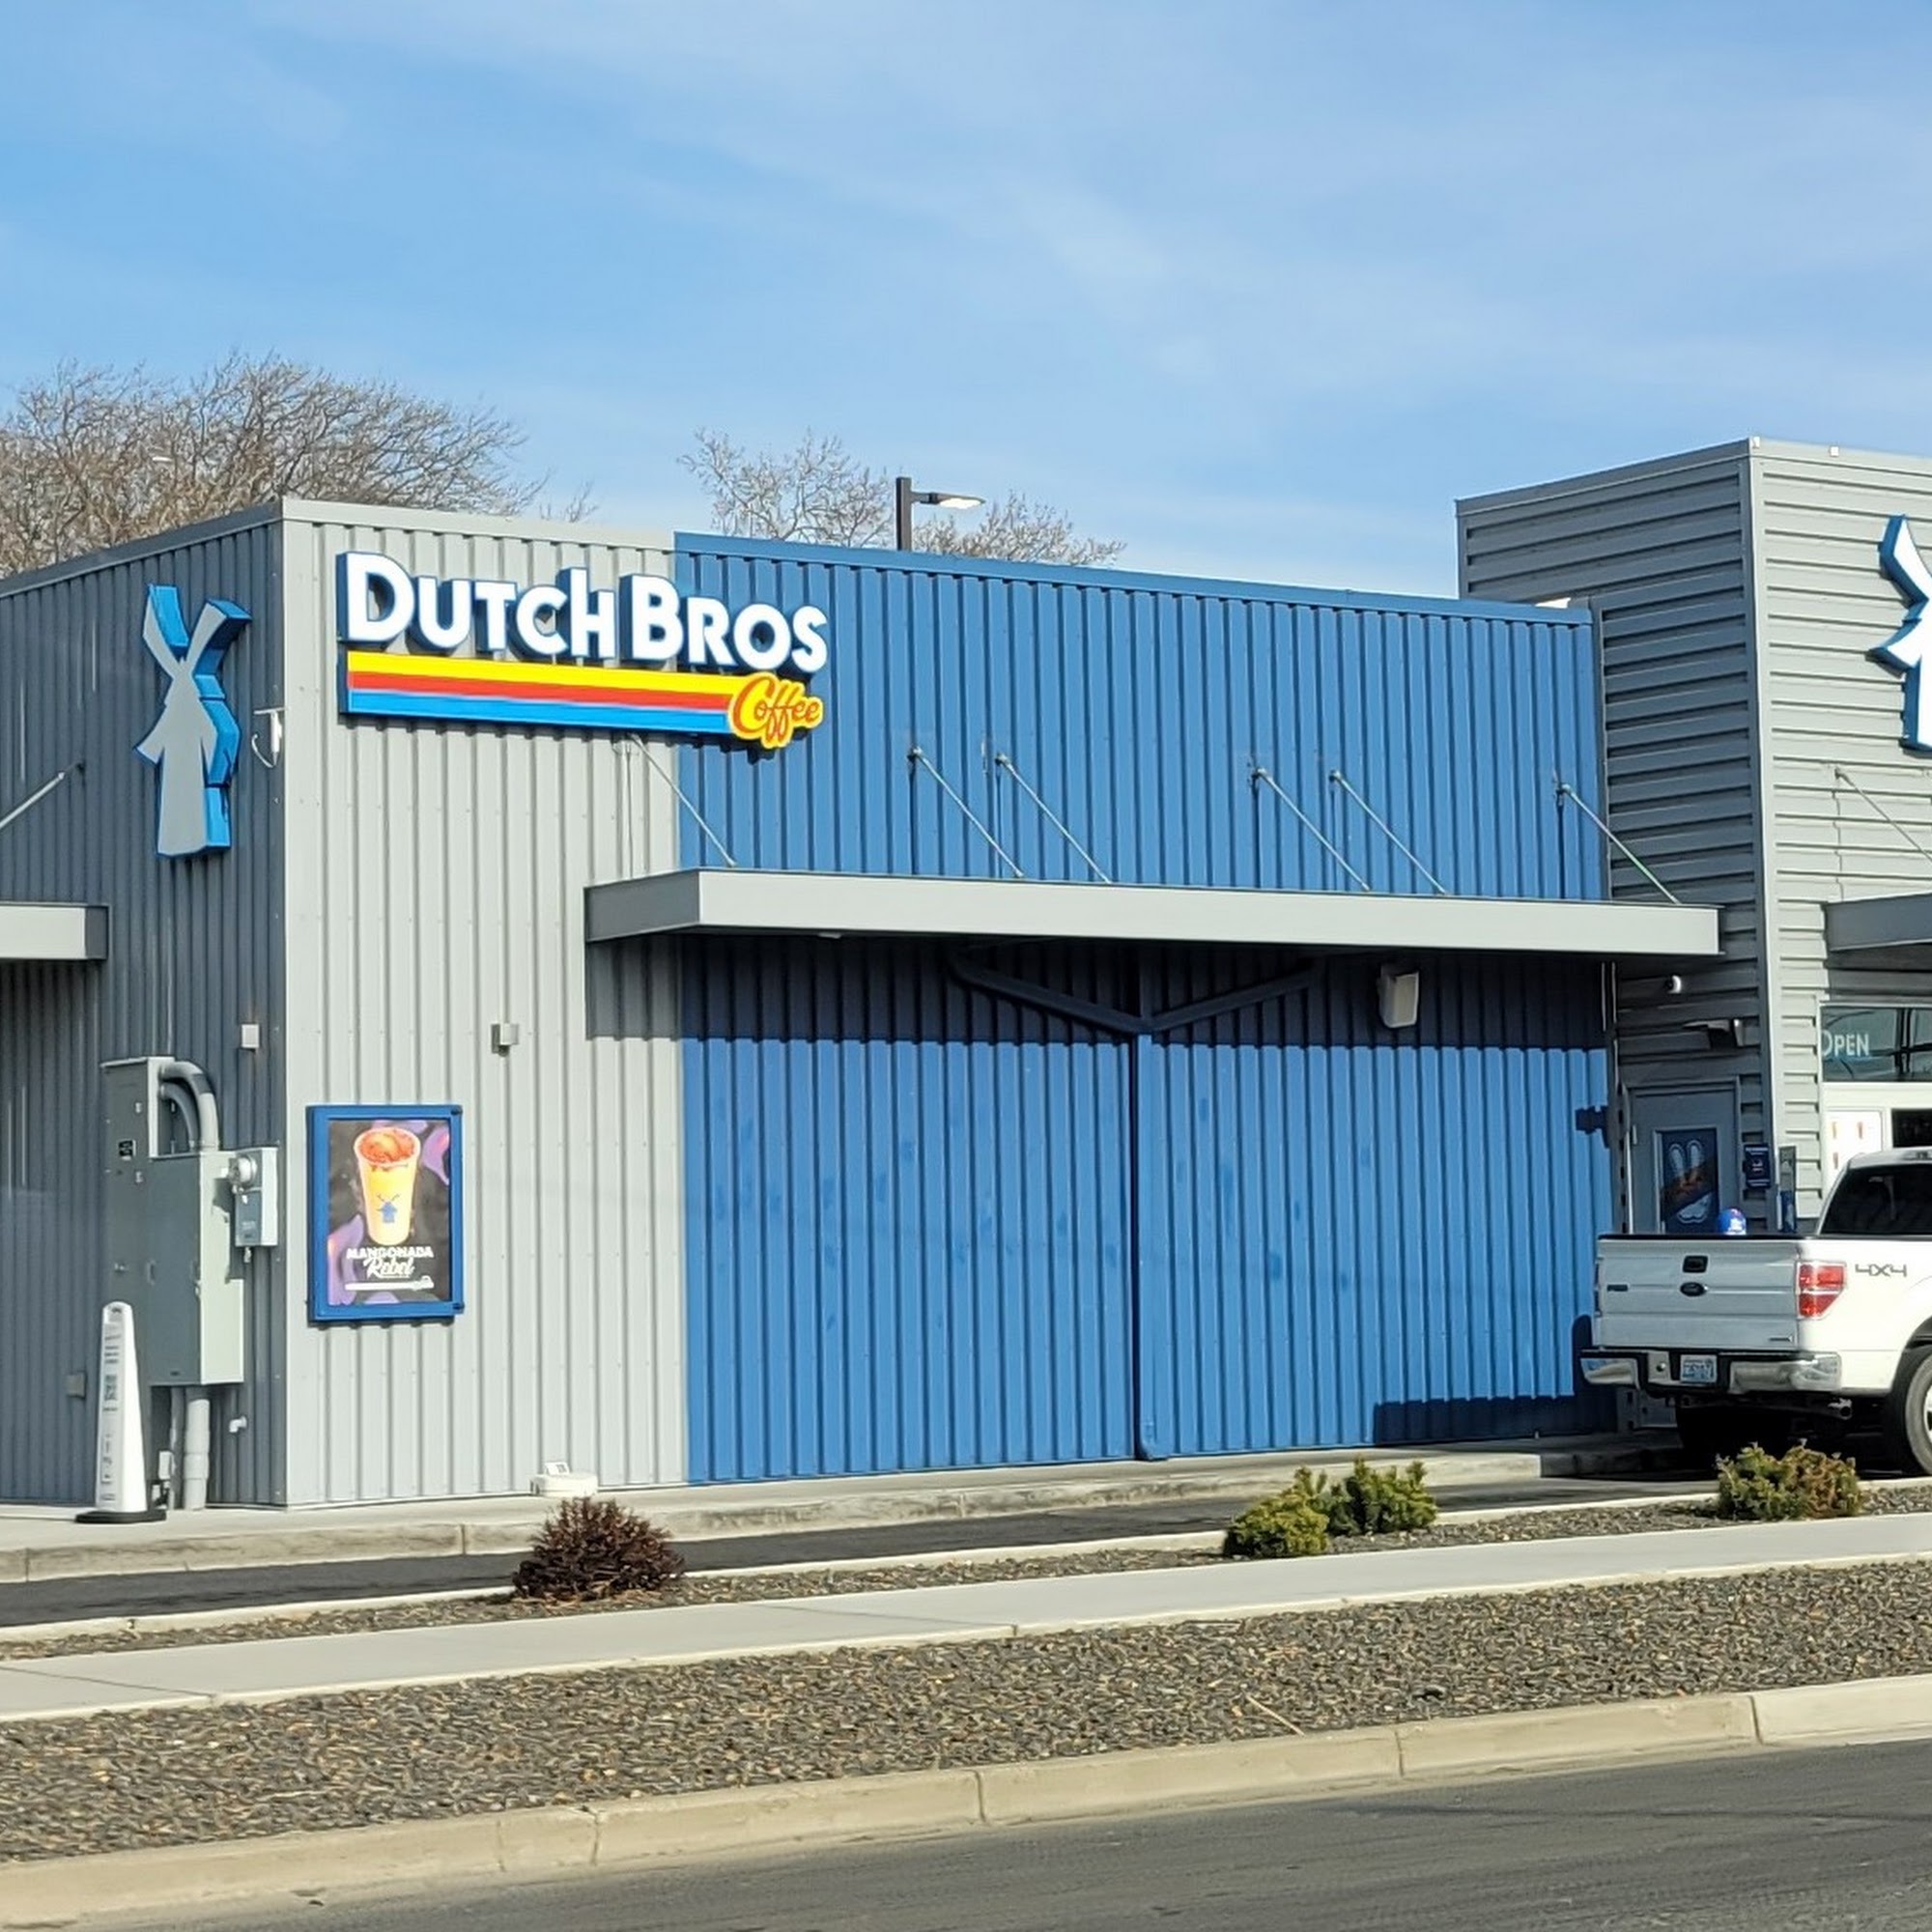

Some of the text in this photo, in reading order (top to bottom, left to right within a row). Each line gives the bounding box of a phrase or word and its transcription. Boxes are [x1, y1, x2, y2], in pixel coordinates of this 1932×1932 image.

[346, 553, 828, 673] DUTCH BROS
[732, 675, 821, 744] Coffee
